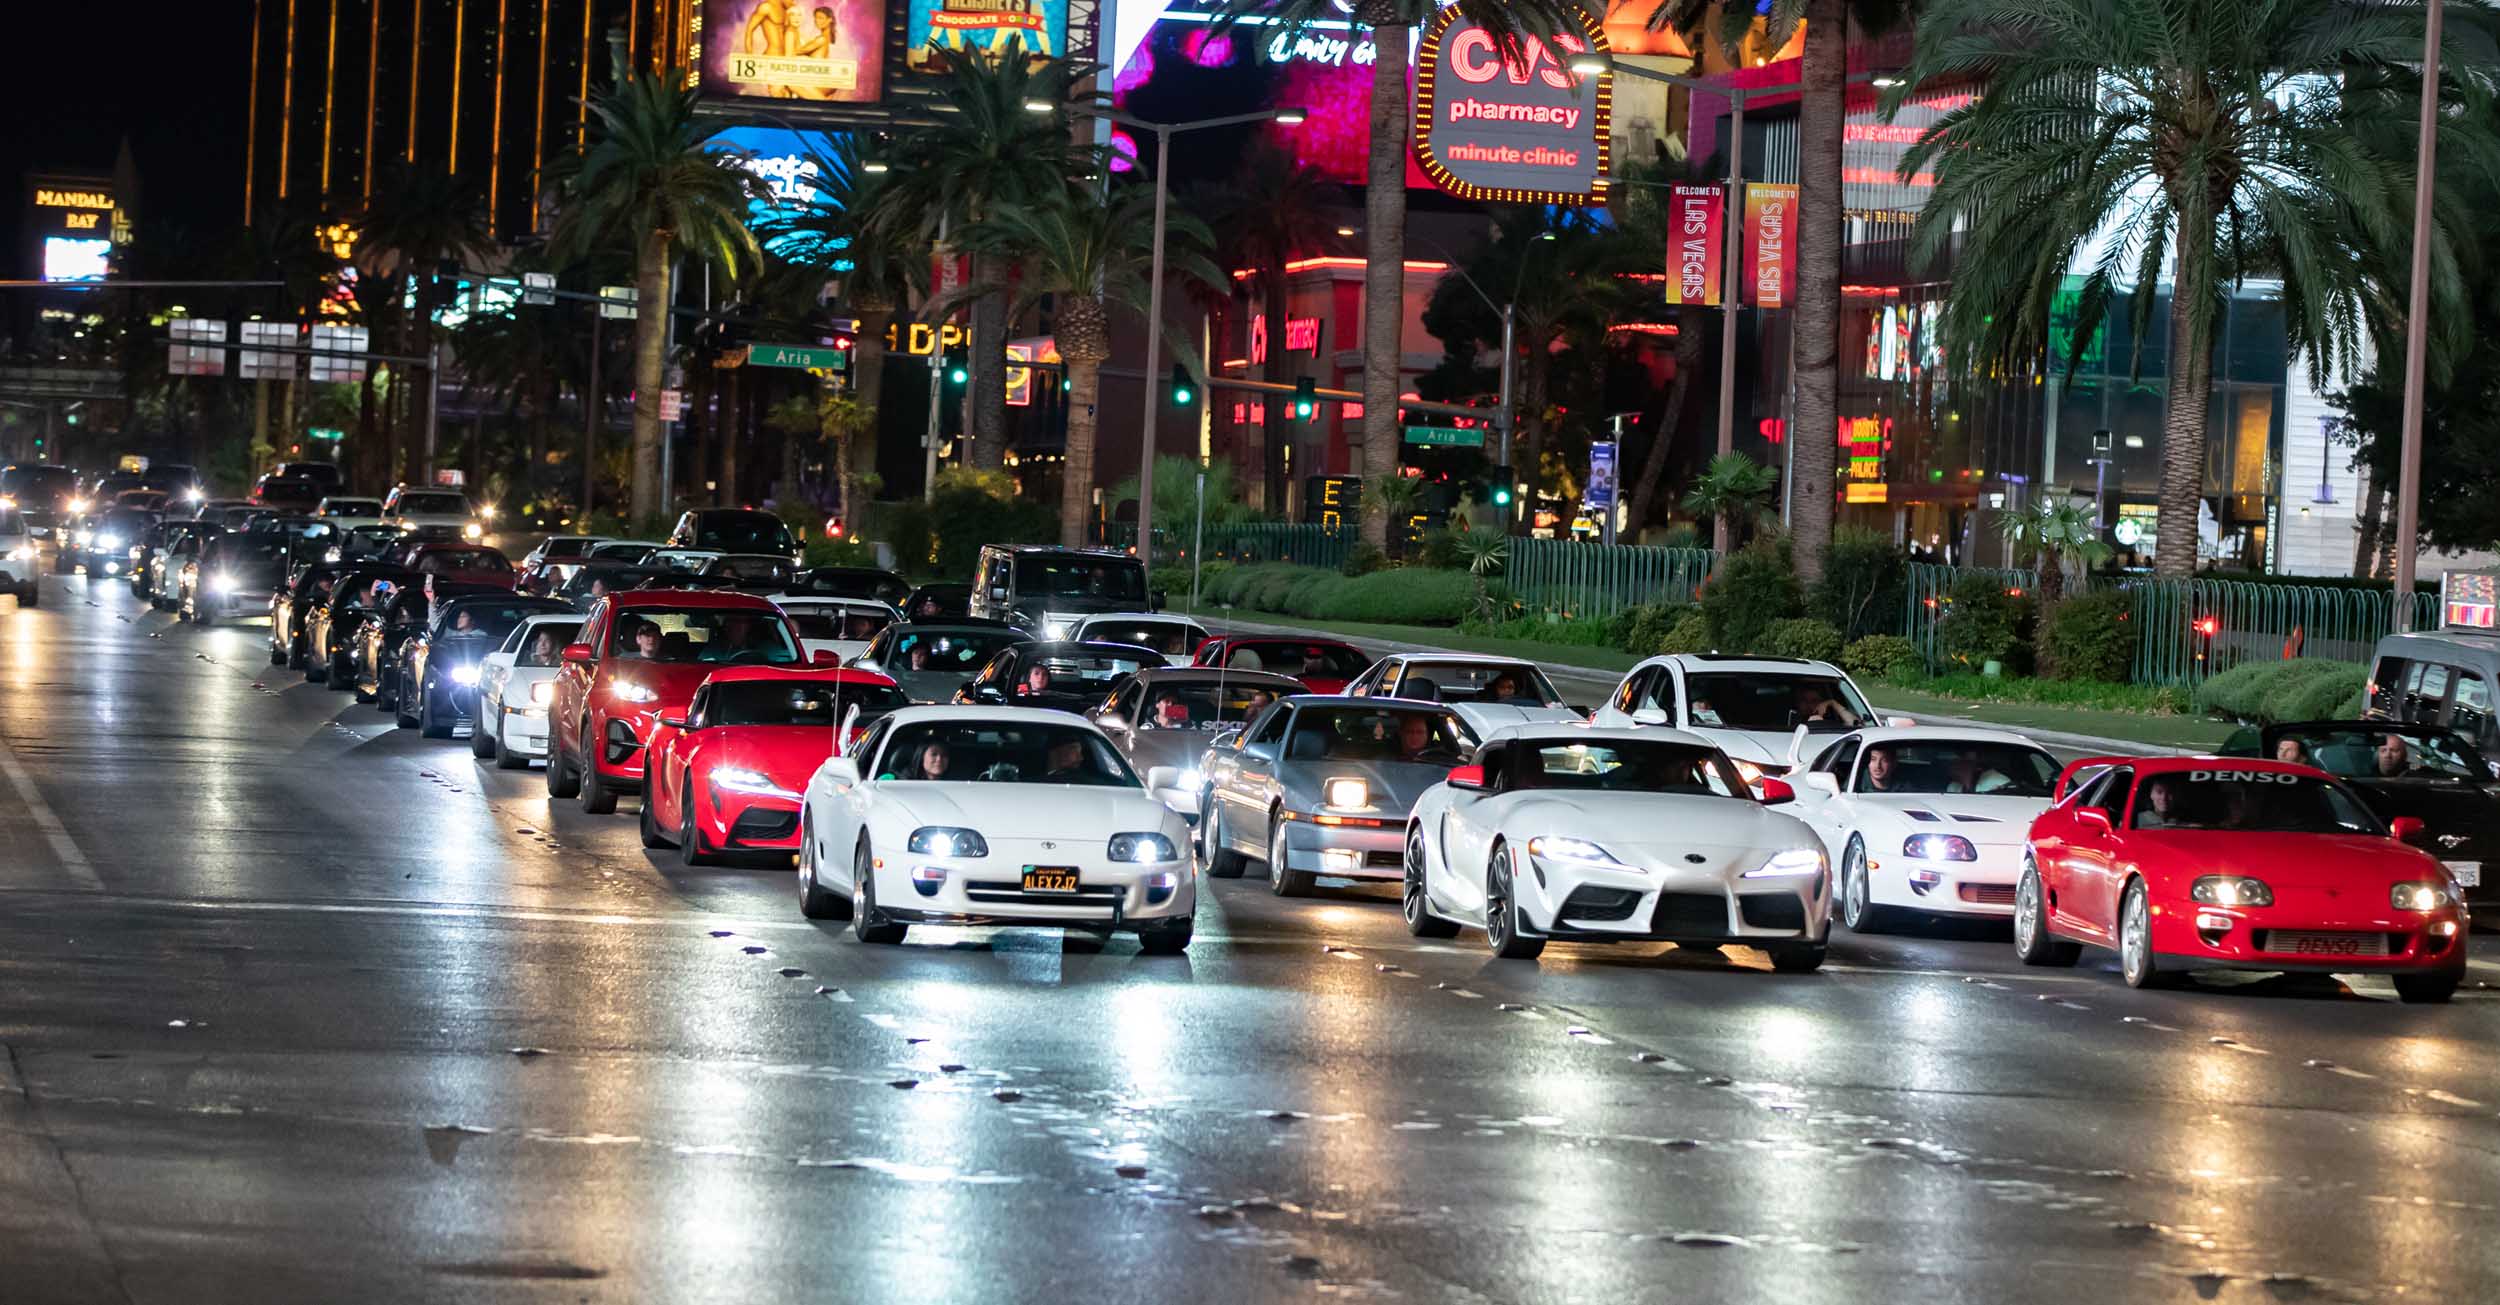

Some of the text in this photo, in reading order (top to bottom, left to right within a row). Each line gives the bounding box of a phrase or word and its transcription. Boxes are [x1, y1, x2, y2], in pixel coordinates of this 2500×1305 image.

[935, 14, 998, 25] CHOCOLATE
[1450, 27, 1585, 88] CVS
[1449, 98, 1580, 129] pharmacy
[1448, 143, 1578, 167] minute clinic
[36, 190, 115, 209] MANDAL
[1675, 186, 1721, 197] WELCOME TO
[1750, 189, 1796, 199] WELCOME TO
[66, 213, 100, 229] BAY
[1682, 199, 1708, 298] LAS VEGAS
[1758, 202, 1783, 302] LAS VEGAS
[775, 350, 811, 365] Aria
[1427, 430, 1456, 442] Aria
[2265, 504, 2277, 565] STARBUCKS
[2189, 769, 2299, 785] DENSO
[2295, 937, 2360, 954] DENSO
